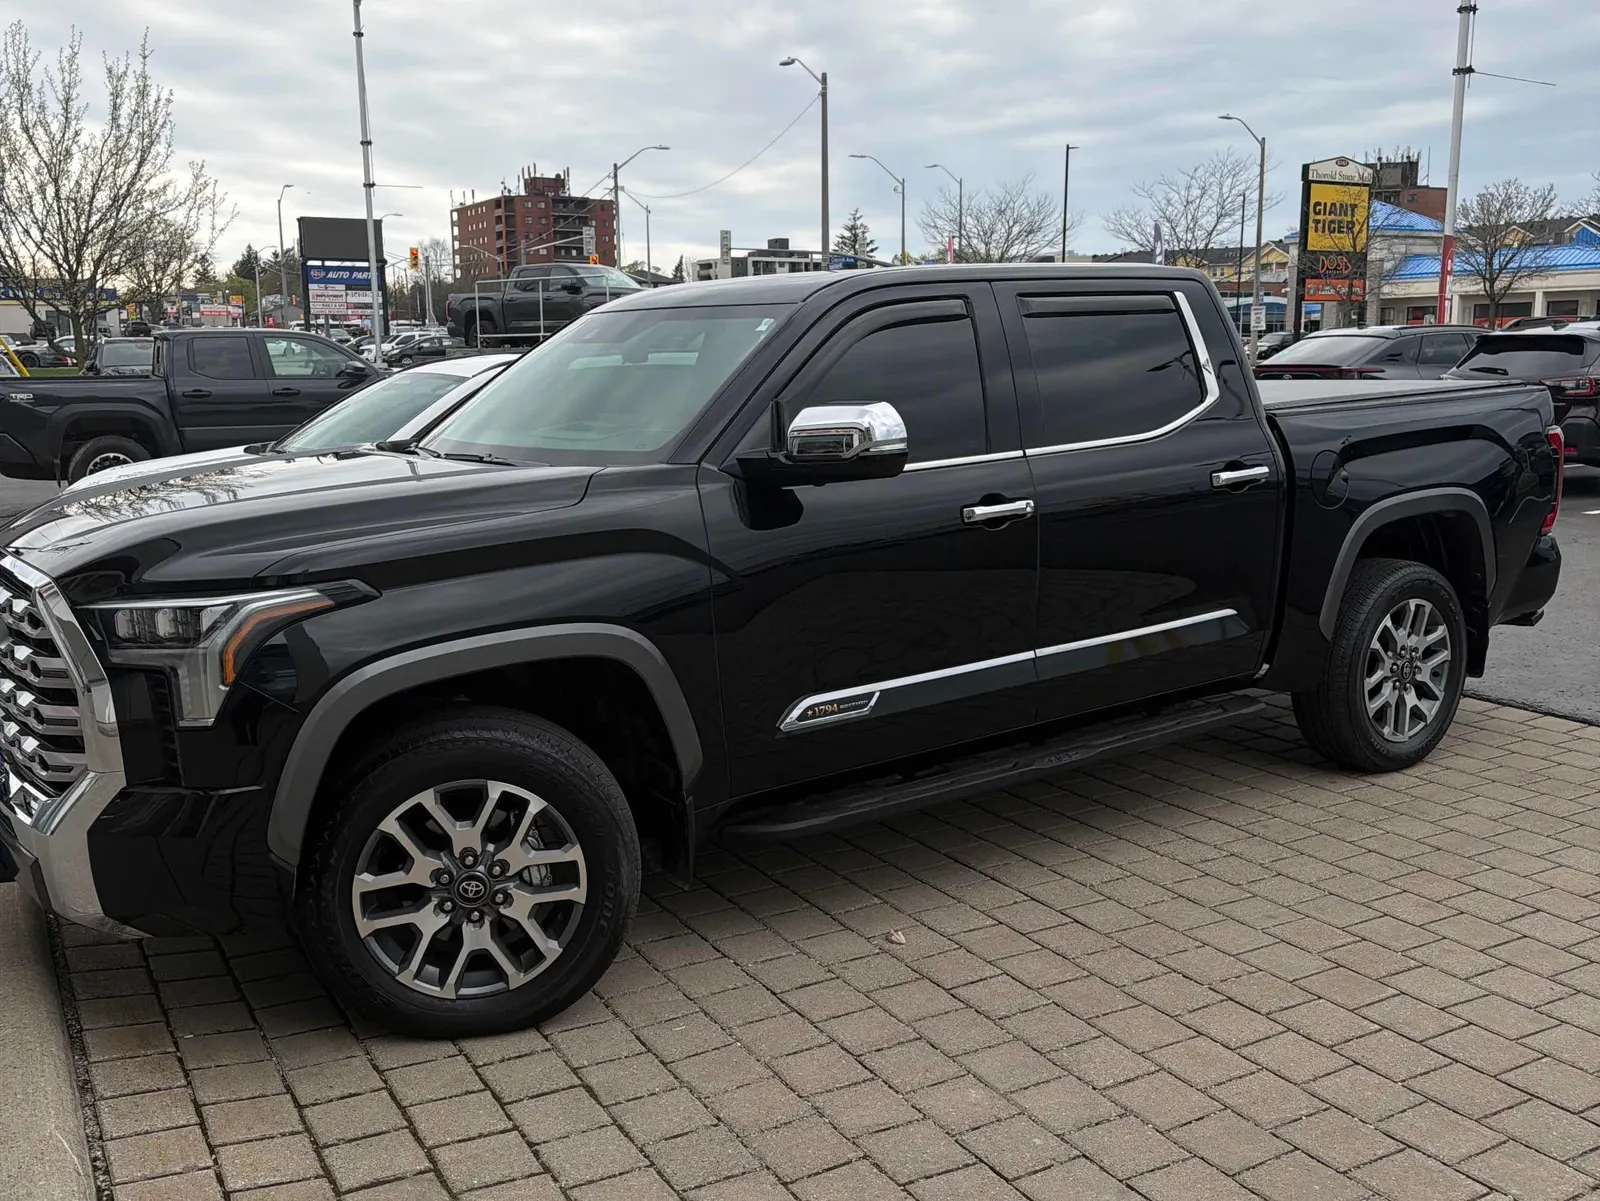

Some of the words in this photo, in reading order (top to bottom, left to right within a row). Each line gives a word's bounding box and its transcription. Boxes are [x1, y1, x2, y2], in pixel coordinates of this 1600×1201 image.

[1311, 169, 1337, 180] Thorold
[1338, 170, 1356, 181] Stone
[1313, 201, 1358, 217] GIANT
[1312, 218, 1356, 235] TIGER
[327, 271, 350, 279] AUTO
[351, 271, 377, 279] PART
[814, 703, 839, 717] 1794
